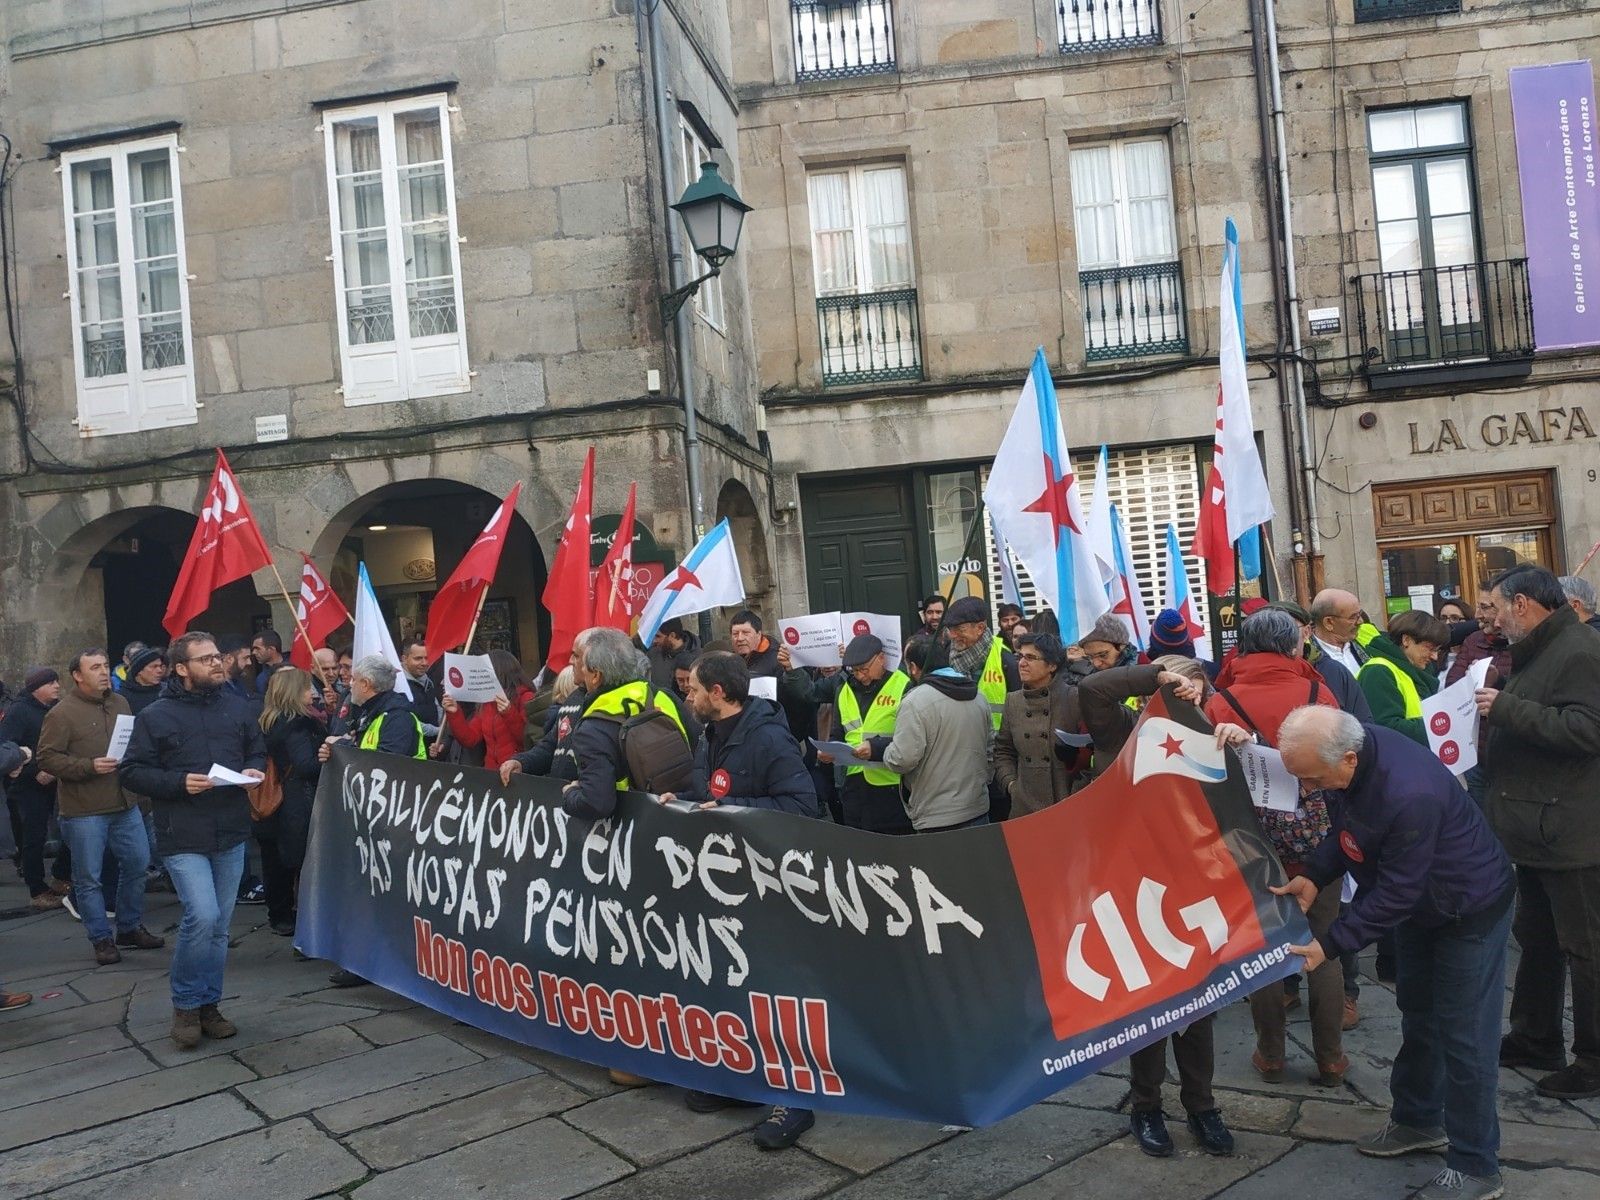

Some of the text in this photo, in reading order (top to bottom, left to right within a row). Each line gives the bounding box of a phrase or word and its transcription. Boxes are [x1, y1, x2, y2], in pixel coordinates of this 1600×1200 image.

[1580, 97, 1595, 187] José Lorenzo
[1559, 99, 1585, 313] Galería de Arte Contemporáneo
[1408, 406, 1598, 454] LA GAFA
[1587, 469, 1597, 482] 9
[1248, 753, 1257, 792] GARANTIDAS
[1260, 756, 1270, 788] MERECIDAS
[355, 835, 749, 987] DAS NOSAS PENSIÓNS
[582, 816, 633, 891] EN
[655, 833, 984, 954] DEFENSA
[414, 916, 470, 996] Non
[471, 949, 539, 1020] aos
[1066, 876, 1229, 1002] CIG
[1042, 942, 1292, 1075] Confederación Intersindical Galega
